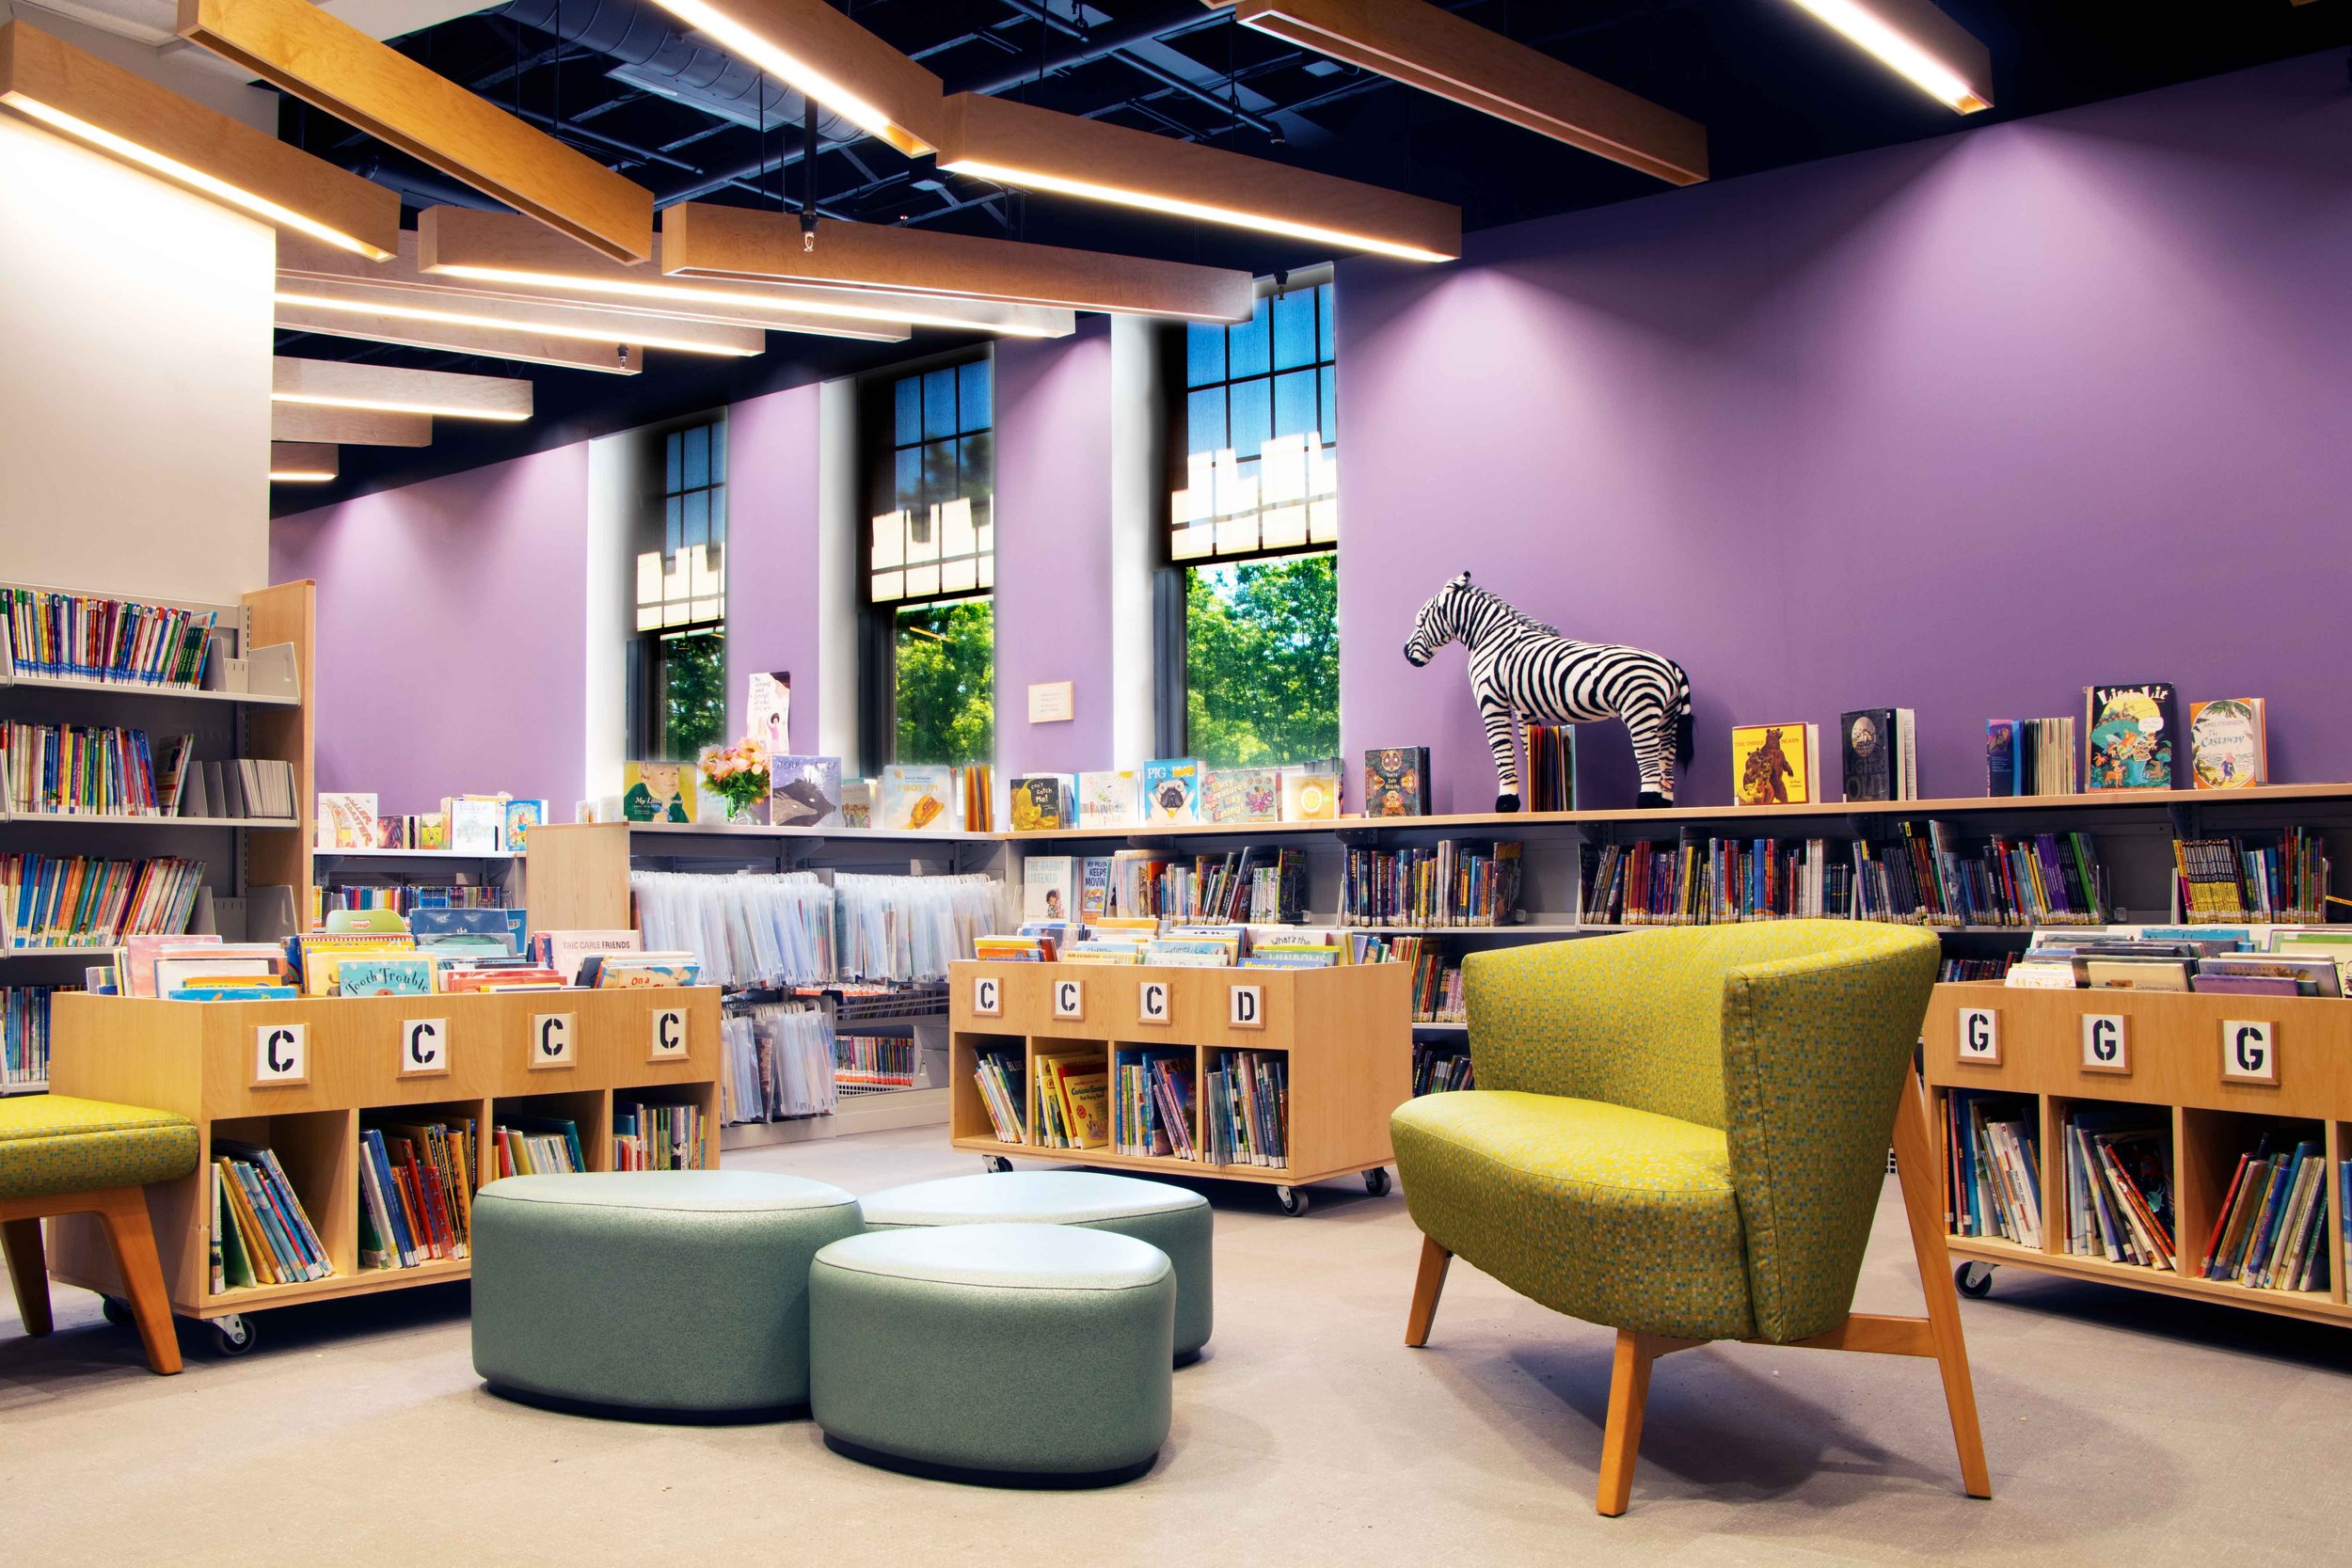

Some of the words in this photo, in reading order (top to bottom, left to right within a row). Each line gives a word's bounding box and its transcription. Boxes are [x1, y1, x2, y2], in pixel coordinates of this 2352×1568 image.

[2140, 685, 2169, 700] Lit
[2201, 736, 2245, 748] Castaway
[1148, 768, 1167, 779] PIG
[903, 784, 924, 792] GOT
[1035, 795, 1048, 803] Me!
[1026, 861, 1040, 872] THE
[1041, 860, 1065, 872] RABBIT
[1089, 867, 1106, 877] KEEPS
[580, 941, 600, 949] CARLE
[601, 941, 630, 949] FRIENDS
[1271, 935, 1296, 945] What's
[1297, 936, 1311, 945] the
[345, 970, 377, 995] Tooth
[379, 967, 428, 993] Trouble
[631, 976, 643, 986] On
[981, 983, 993, 1008] C
[1062, 984, 1075, 1010] C
[1147, 987, 1162, 1014] C
[1238, 992, 1254, 1021] D
[543, 1019, 563, 1055] C
[660, 1014, 678, 1049] C
[1969, 1014, 1988, 1051] G
[2093, 1020, 2116, 1060] G
[268, 1031, 294, 1071] C
[412, 1024, 435, 1063] C
[2237, 1027, 2263, 1070] G
[1006, 1060, 1025, 1072] BLUE
[1071, 1086, 1091, 1095] Curious
